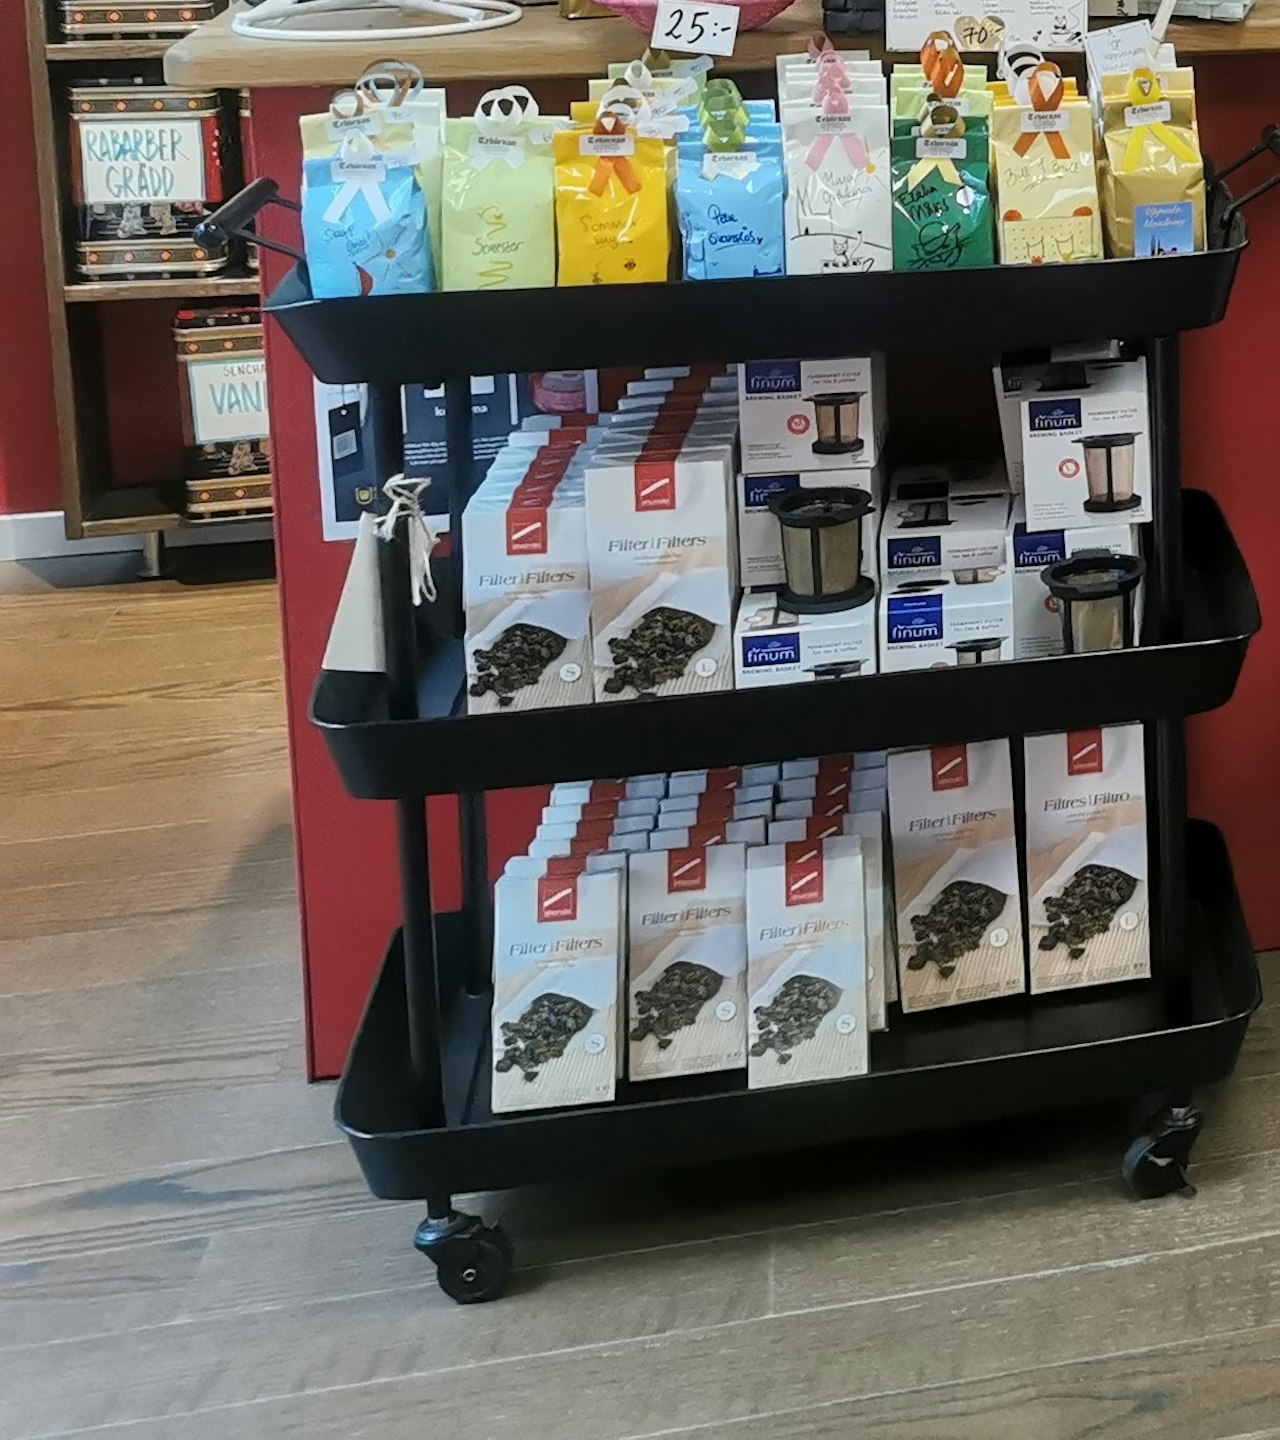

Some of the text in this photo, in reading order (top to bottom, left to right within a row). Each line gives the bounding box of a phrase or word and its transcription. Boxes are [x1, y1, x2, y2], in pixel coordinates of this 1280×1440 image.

[664, 9, 731, 44] 25:-
[86, 128, 188, 163] RABARBER
[105, 167, 175, 199] GRÄDD
[750, 374, 797, 390] finum
[1034, 414, 1080, 429] finum
[607, 535, 706, 553] Filter Filters
[1043, 791, 1130, 813] Filtres Filtro
[641, 904, 732, 926] Filter Filters
